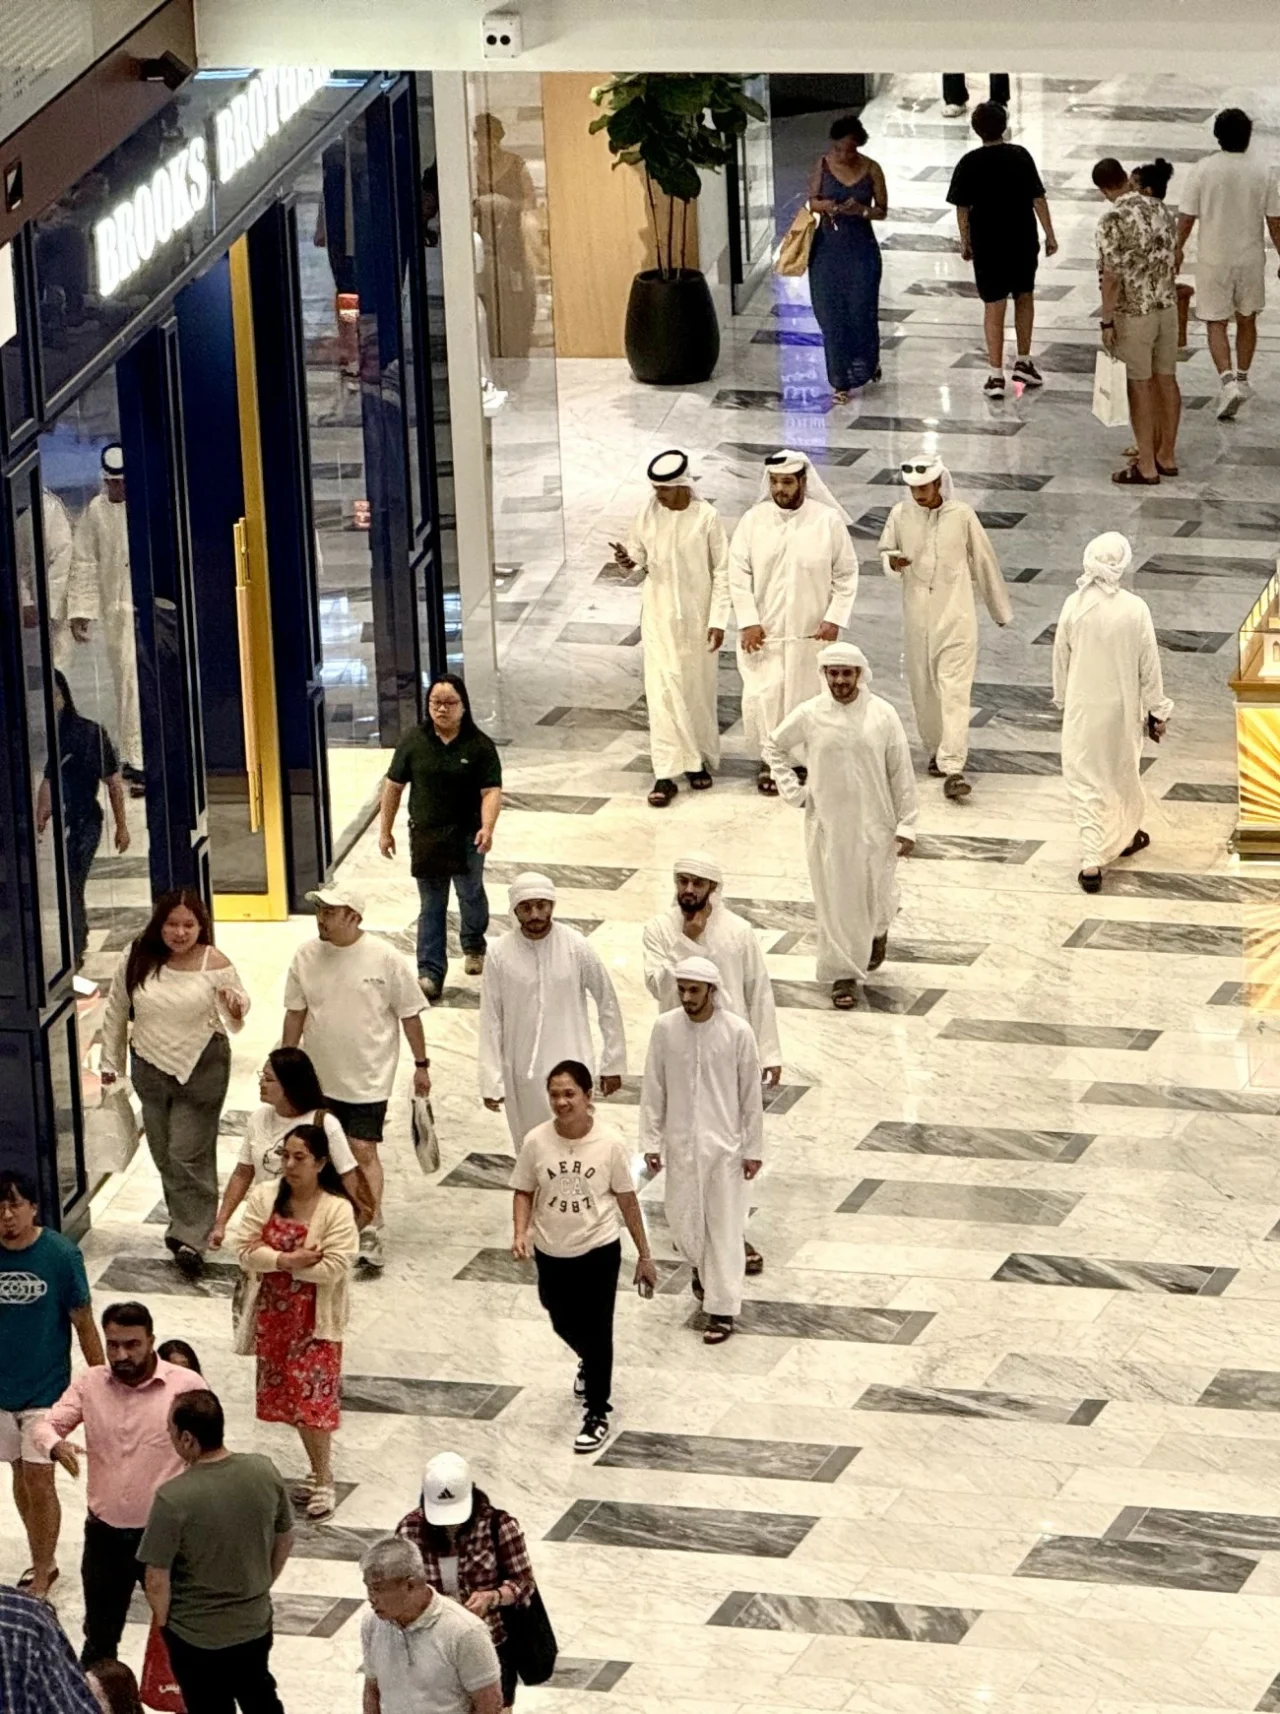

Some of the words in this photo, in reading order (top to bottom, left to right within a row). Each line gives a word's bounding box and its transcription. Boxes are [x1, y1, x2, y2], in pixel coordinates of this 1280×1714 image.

[96, 136, 208, 297] BROOKS
[217, 67, 330, 184] BROTHE
[546, 1161, 596, 1180] AERO
[548, 1196, 591, 1213] 1987
[0, 1282, 42, 1295] COSTE
